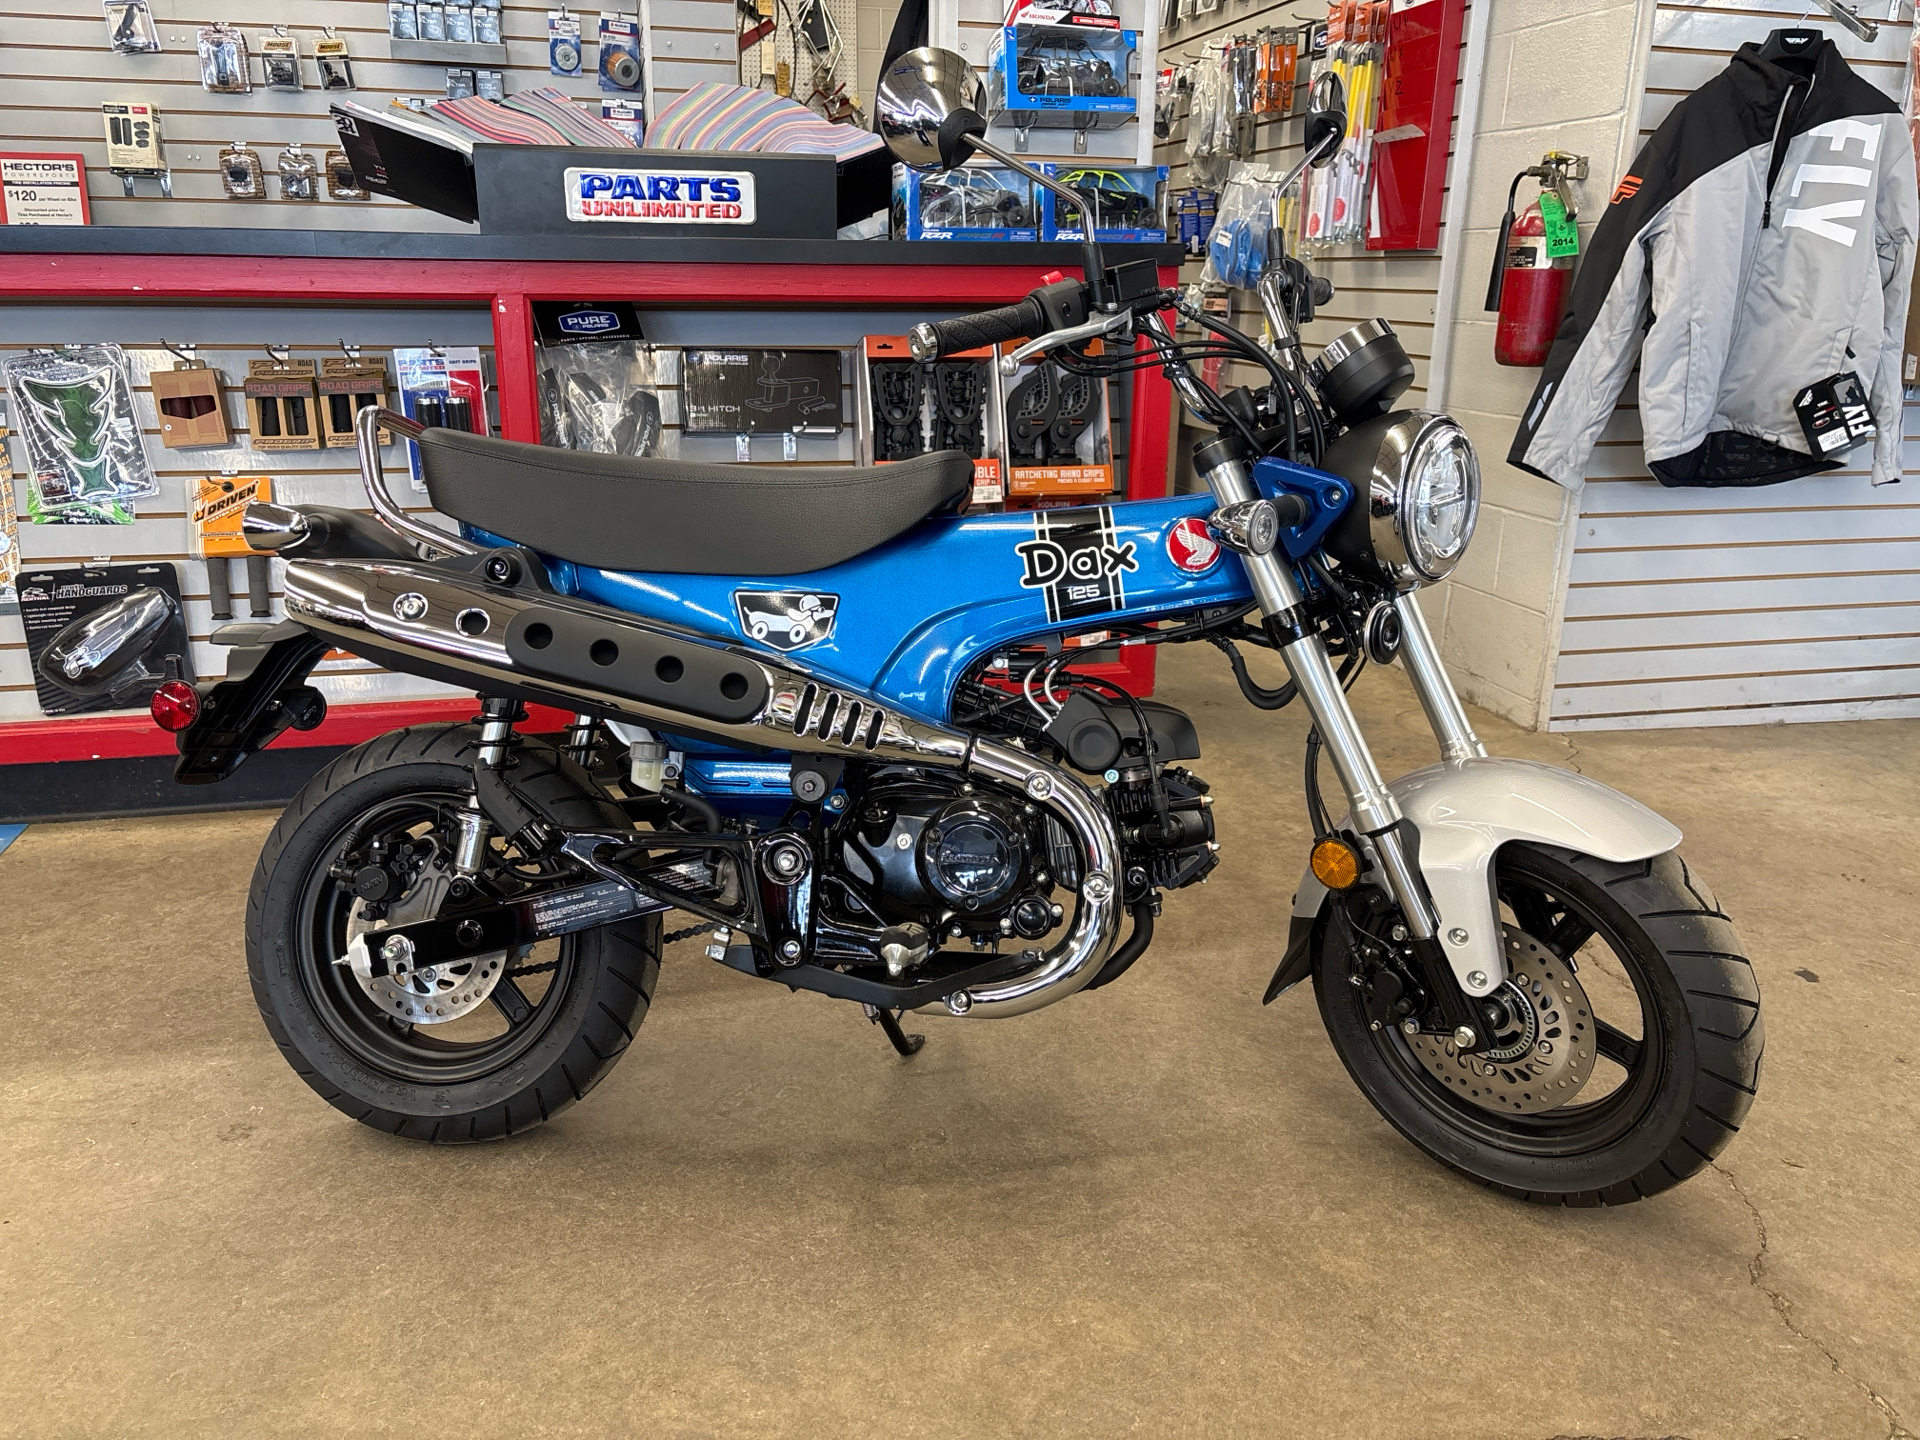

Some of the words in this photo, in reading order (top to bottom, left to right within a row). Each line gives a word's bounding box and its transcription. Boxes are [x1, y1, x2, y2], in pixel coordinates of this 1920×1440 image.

[3, 163, 74, 171] HECTOR'S
[579, 173, 742, 202] PARTS
[1782, 119, 1882, 248] FLY
[8, 190, 37, 201] $120
[581, 200, 742, 219] UNLIMITED
[920, 232, 953, 240] RZR
[1552, 237, 1574, 247] 2014
[567, 315, 610, 326] PURE
[705, 354, 749, 362] POLARIS
[246, 384, 276, 392] ROAD
[278, 383, 311, 392] GRIPS
[320, 381, 349, 390] ROAD
[351, 380, 383, 389] GRIPS
[1842, 404, 1876, 437] FLY
[975, 466, 996, 478] IBLE
[1015, 470, 1058, 479] RATCHETING
[1060, 469, 1081, 478] RHINO
[1083, 468, 1104, 478] GRIPS
[208, 484, 256, 516] DRIVEN
[1014, 540, 1140, 589] Dax
[56, 585, 128, 599] HANDGUARDS
[1066, 584, 1100, 600] 125
